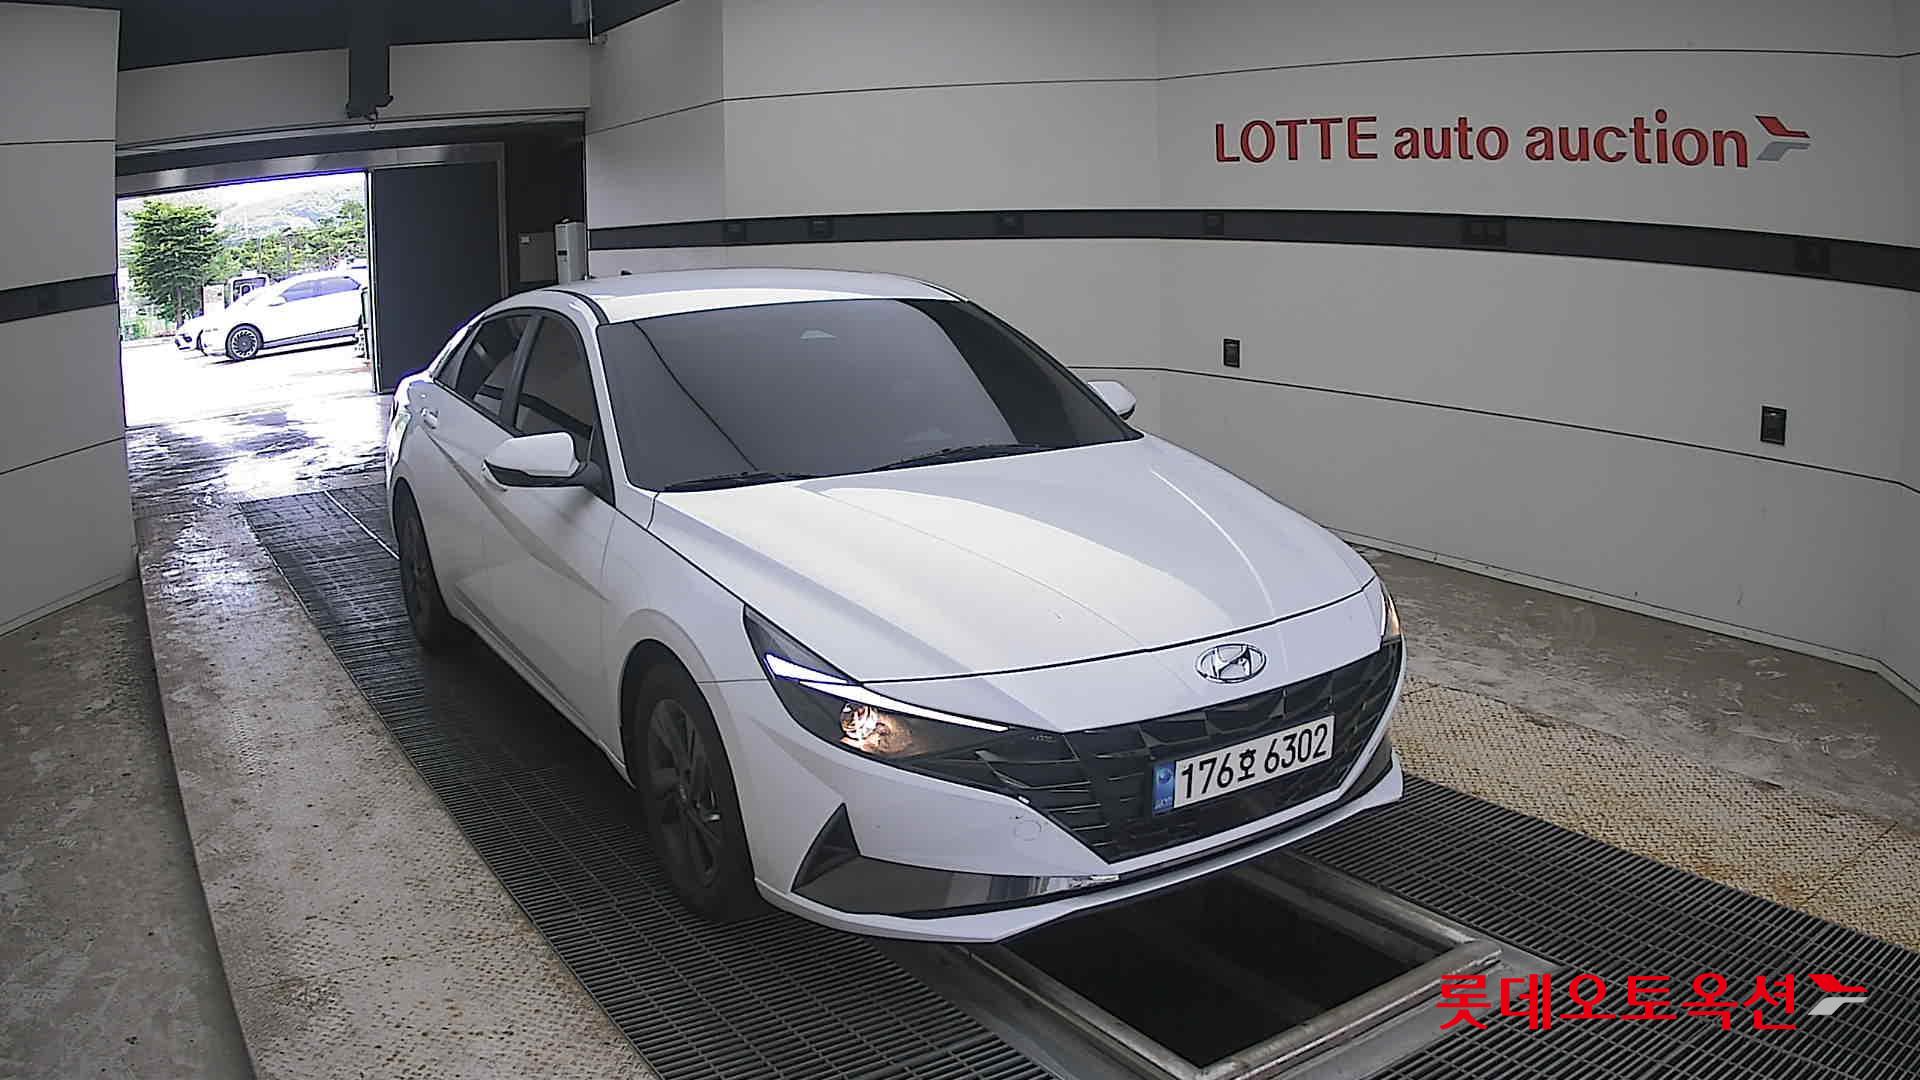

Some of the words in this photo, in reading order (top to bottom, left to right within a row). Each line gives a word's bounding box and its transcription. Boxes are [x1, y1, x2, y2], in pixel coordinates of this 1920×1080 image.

[1214, 115, 1379, 164] LOTTE
[1393, 116, 1510, 161] auto
[1525, 108, 1749, 169] auction
[1181, 748, 1257, 799] 176호
[1264, 723, 1328, 774] 6302
